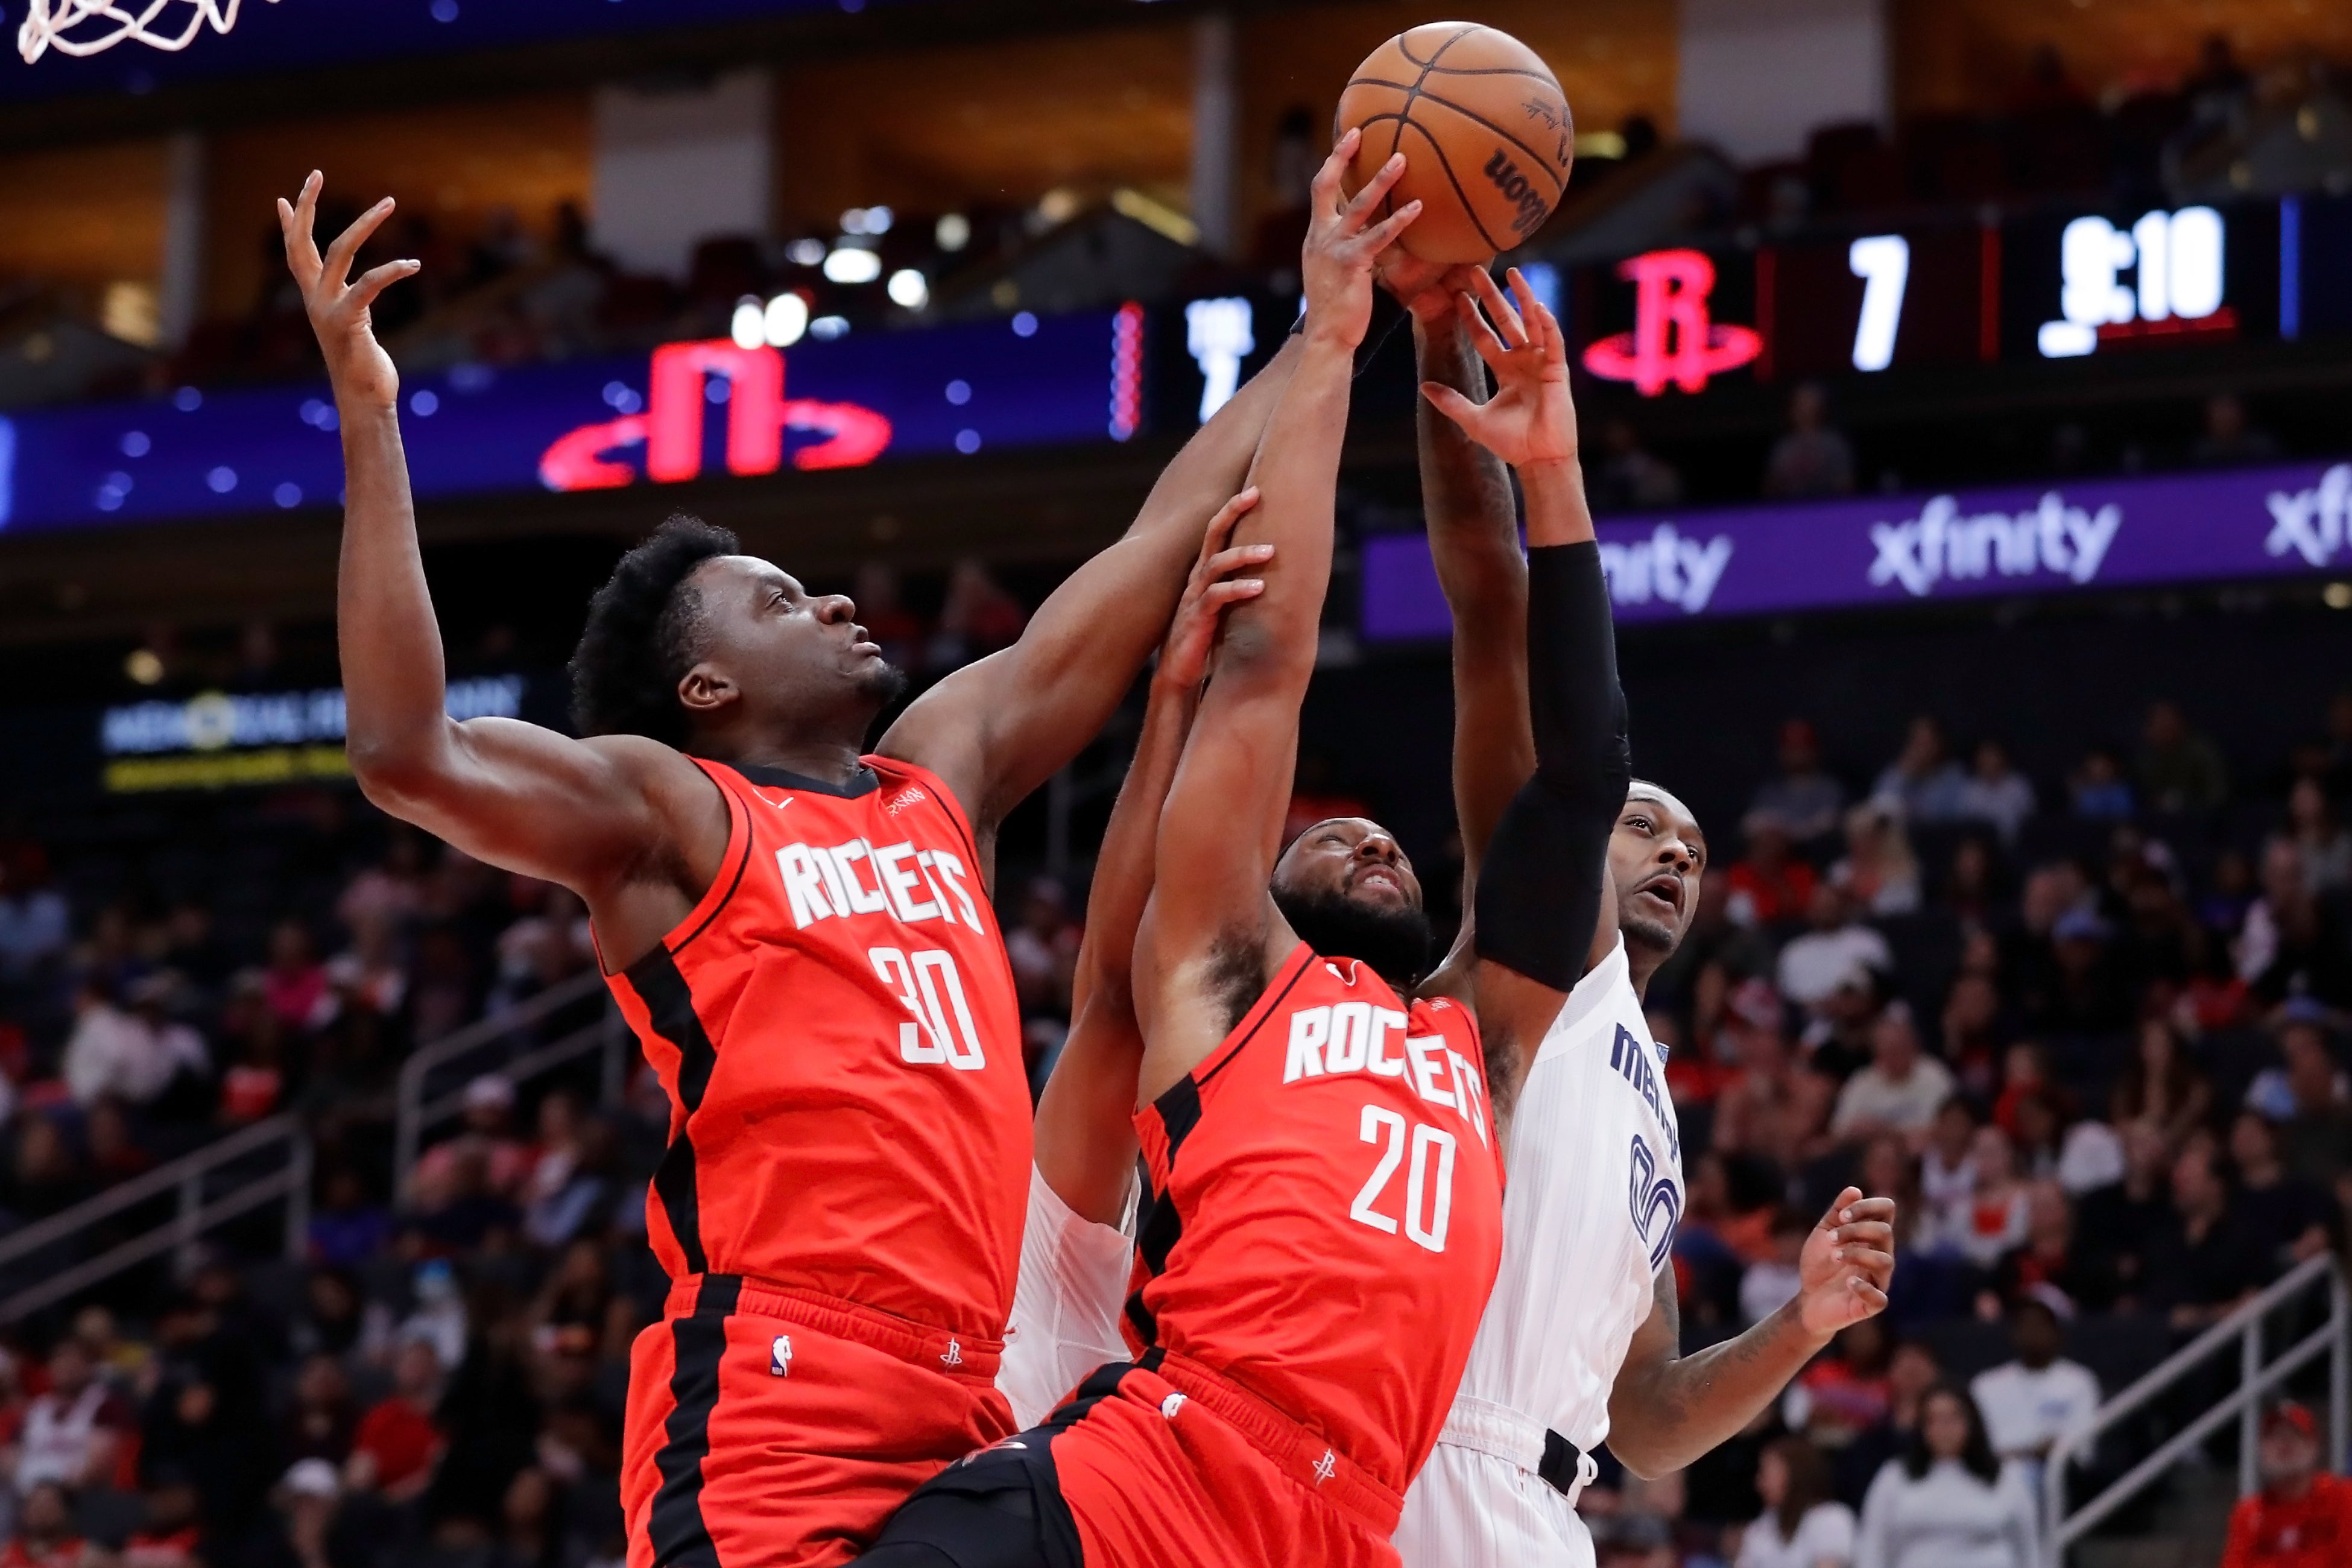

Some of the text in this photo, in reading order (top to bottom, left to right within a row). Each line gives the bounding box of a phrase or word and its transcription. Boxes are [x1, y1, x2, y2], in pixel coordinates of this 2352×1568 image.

[1849, 234, 1910, 371] 7
[1599, 522, 1734, 614] nity
[1869, 485, 2122, 596] xfinity
[868, 947, 986, 1070] 30
[1350, 1104, 1456, 1253] 20
